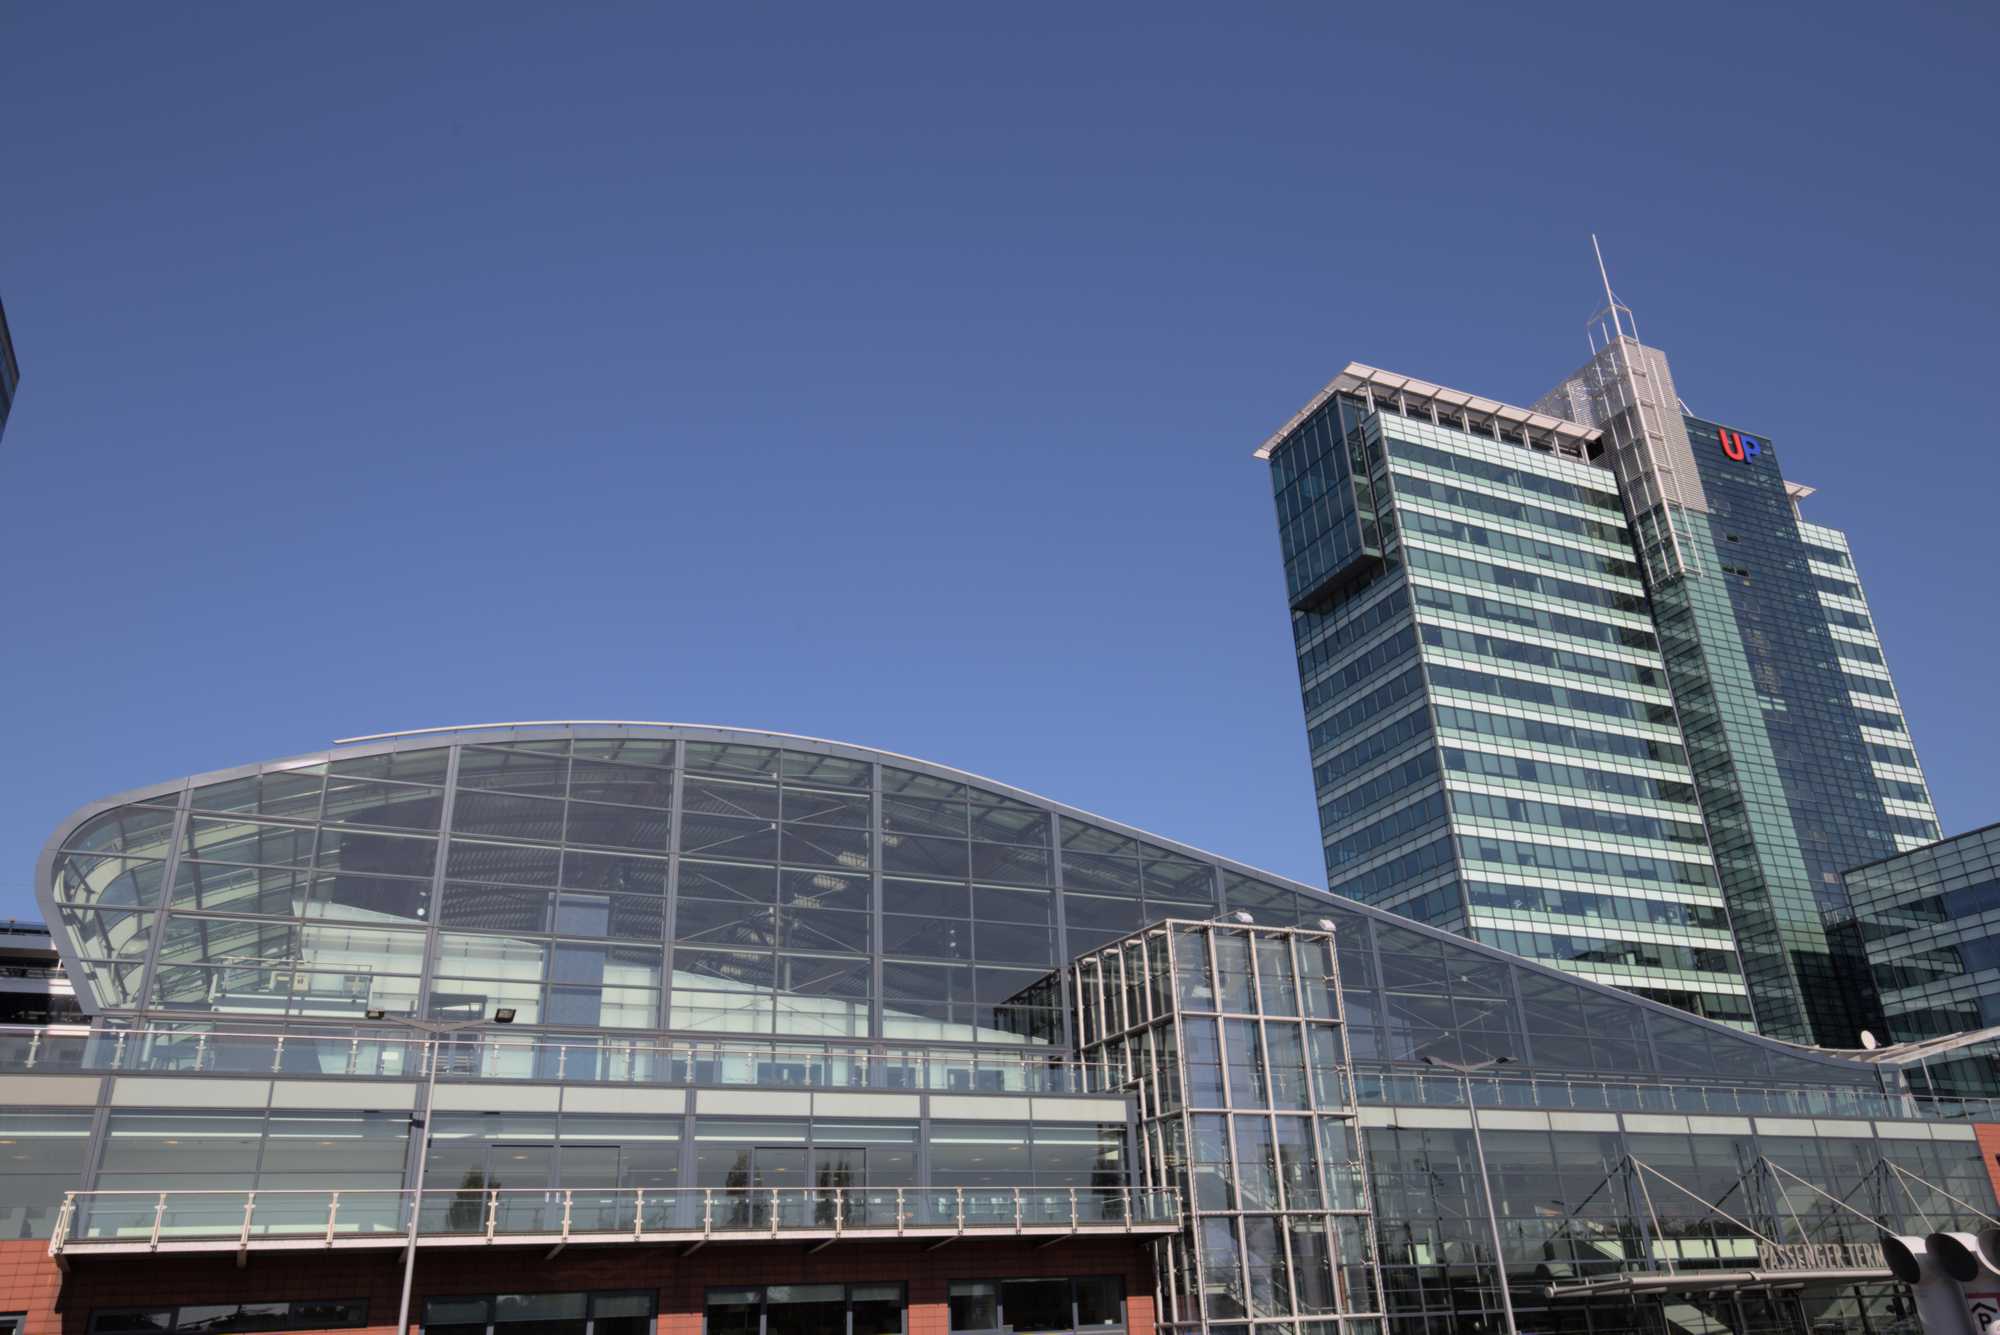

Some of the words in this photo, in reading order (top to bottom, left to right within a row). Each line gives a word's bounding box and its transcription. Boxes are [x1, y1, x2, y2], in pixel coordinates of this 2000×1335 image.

[1718, 426, 1761, 464] UP
[1759, 1243, 1845, 1271] PASSENGER
[1978, 1312, 1992, 1332] P
